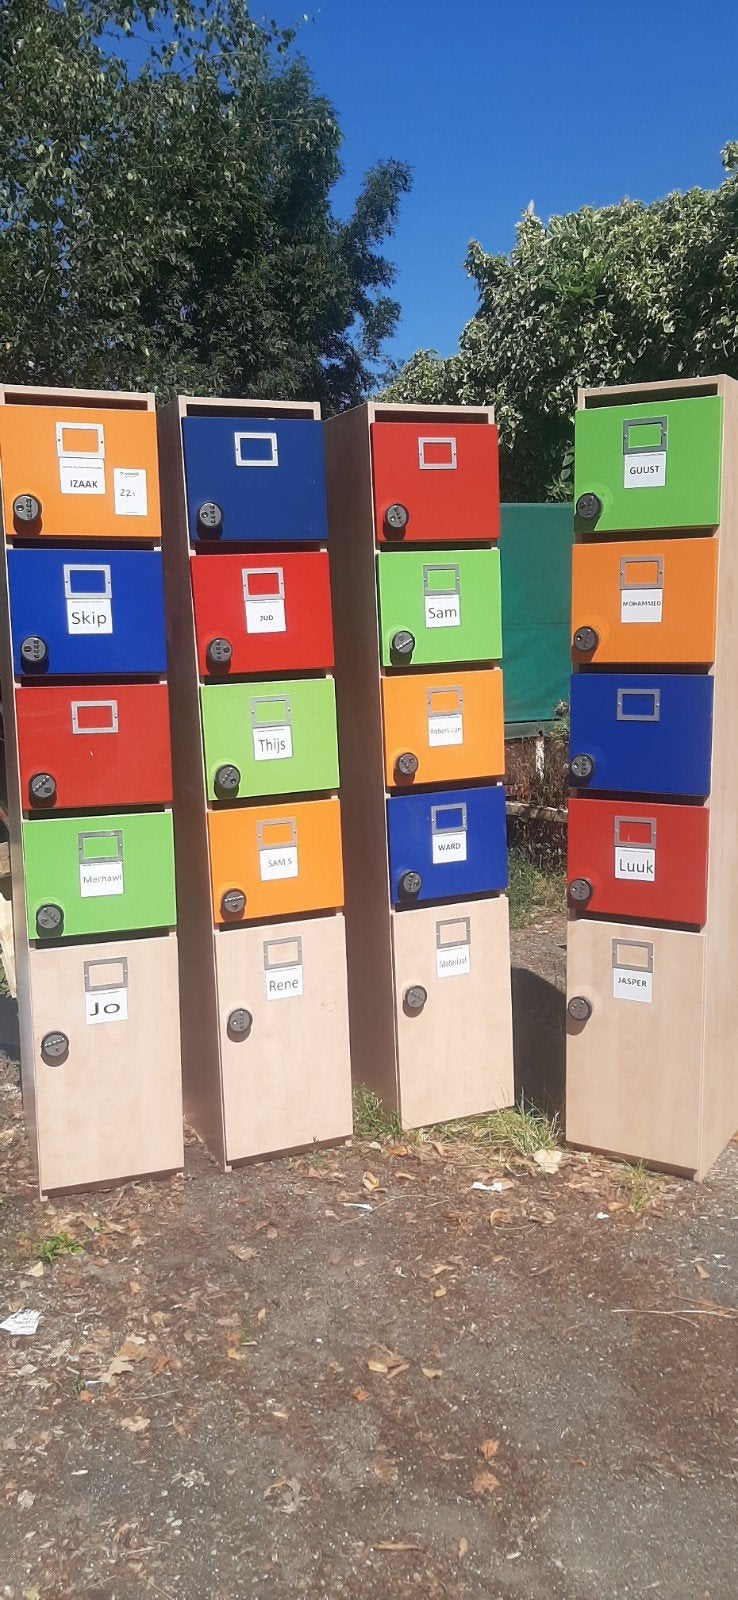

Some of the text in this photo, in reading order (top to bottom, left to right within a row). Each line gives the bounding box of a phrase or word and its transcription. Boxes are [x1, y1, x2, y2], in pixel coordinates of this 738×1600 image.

[629, 465, 660, 475] GUUST
[70, 480, 98, 488] IZAAK
[71, 610, 107, 628] Skip
[259, 614, 274, 622] JUD
[428, 607, 457, 619] Sam
[258, 738, 286, 754] Thijs
[437, 842, 461, 852] WARD
[619, 858, 654, 874] Luuk
[269, 979, 299, 992] Rene
[617, 976, 648, 988] JASPER
[89, 1002, 121, 1017] Jo
